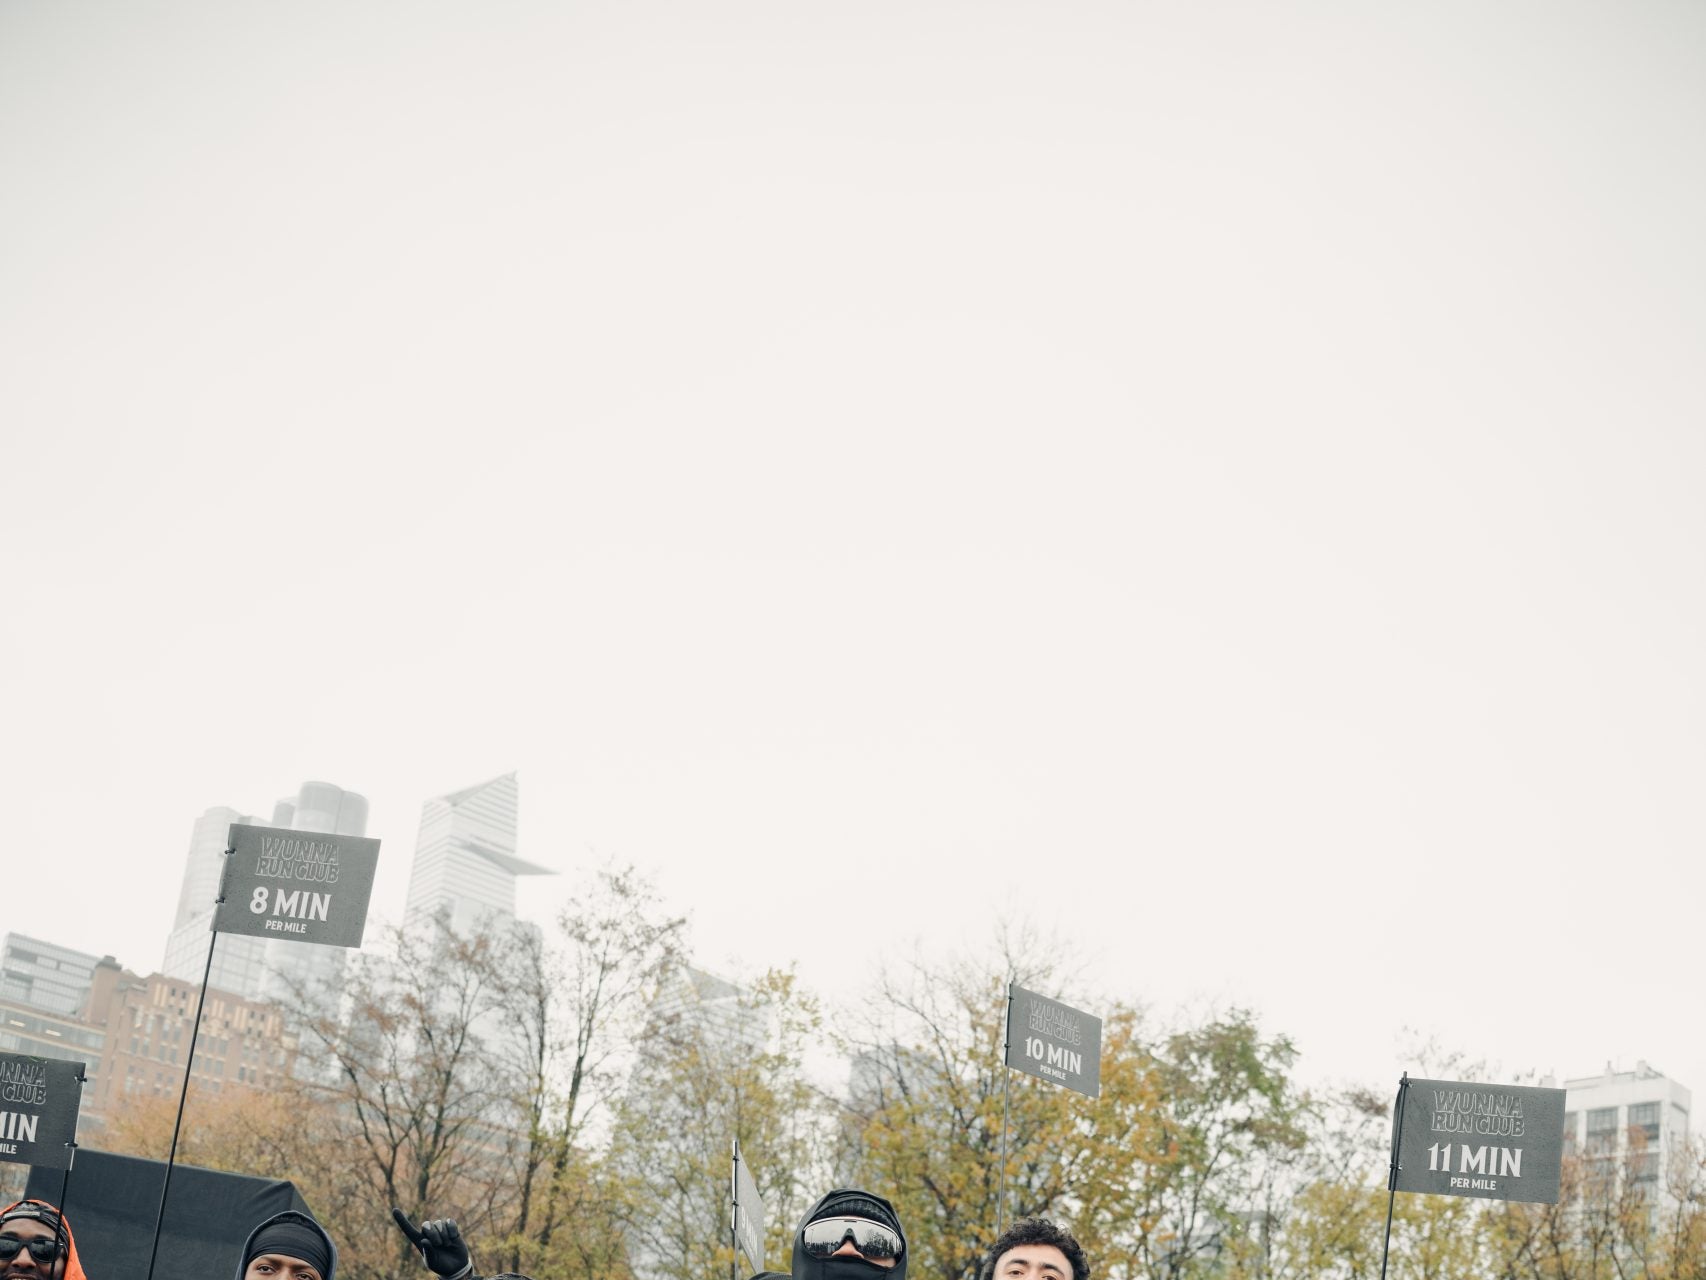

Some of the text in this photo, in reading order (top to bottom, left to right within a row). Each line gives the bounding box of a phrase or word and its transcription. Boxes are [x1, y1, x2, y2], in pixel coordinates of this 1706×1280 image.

[262, 837, 339, 866] WUNNA
[255, 857, 340, 883] RUN CLUB
[250, 886, 332, 921] 8 MIN
[265, 920, 307, 933] PER MILE
[1025, 1036, 1082, 1075] 10 MIN
[0, 1061, 46, 1087] NNA
[1040, 1064, 1066, 1080] PER MILE
[3, 1083, 46, 1105] CLUB
[1433, 1090, 1524, 1118] WUNNA
[1431, 1112, 1525, 1137] RUN CLUB
[0, 1143, 17, 1155] ILE
[1427, 1142, 1523, 1177] 11 MIN
[1450, 1177, 1497, 1190] PER MILE
